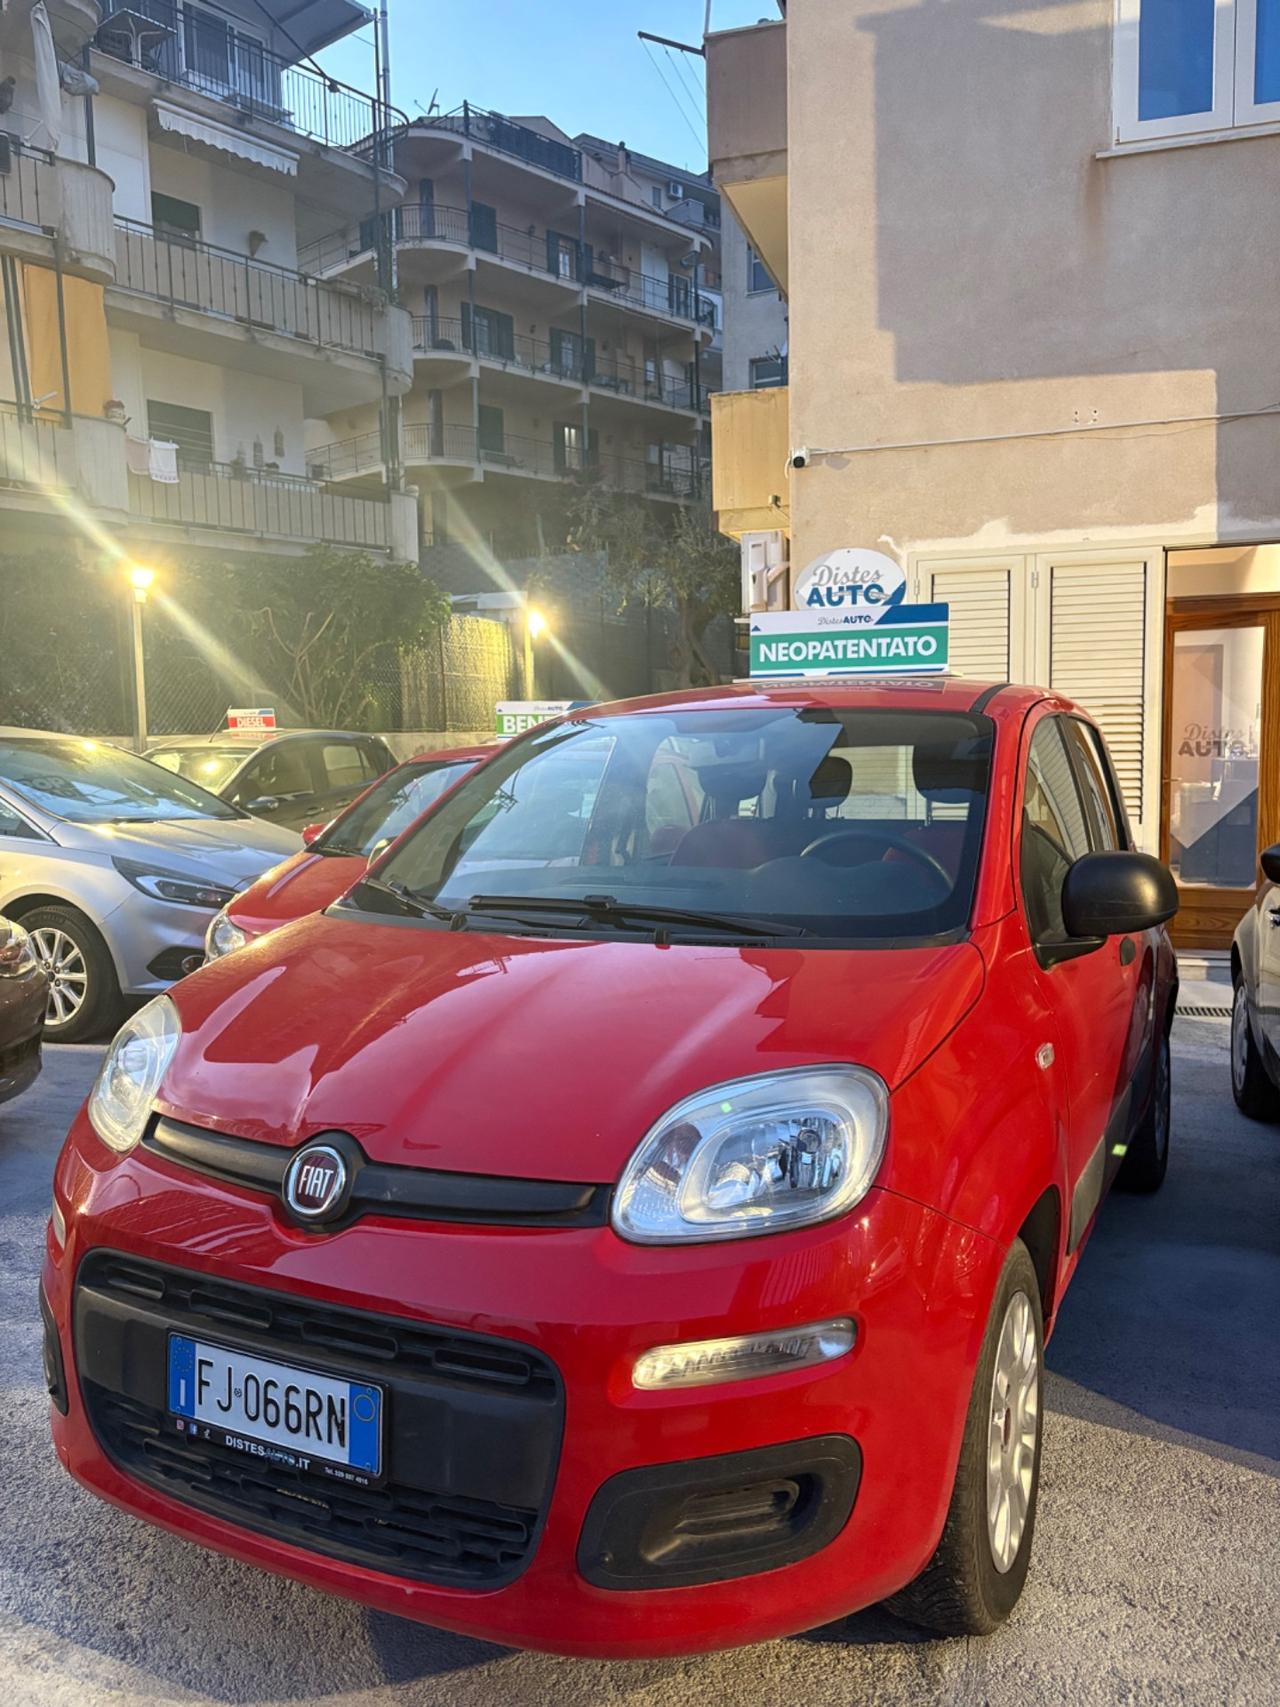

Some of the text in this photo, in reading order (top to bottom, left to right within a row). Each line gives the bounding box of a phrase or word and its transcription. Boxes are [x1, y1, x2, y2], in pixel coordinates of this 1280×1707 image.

[812, 564, 884, 586] Distes
[806, 583, 885, 607] AUTO
[759, 635, 937, 662] NEOPATENTATO
[502, 715, 555, 734] BEN
[298, 1165, 334, 1199] FIAT
